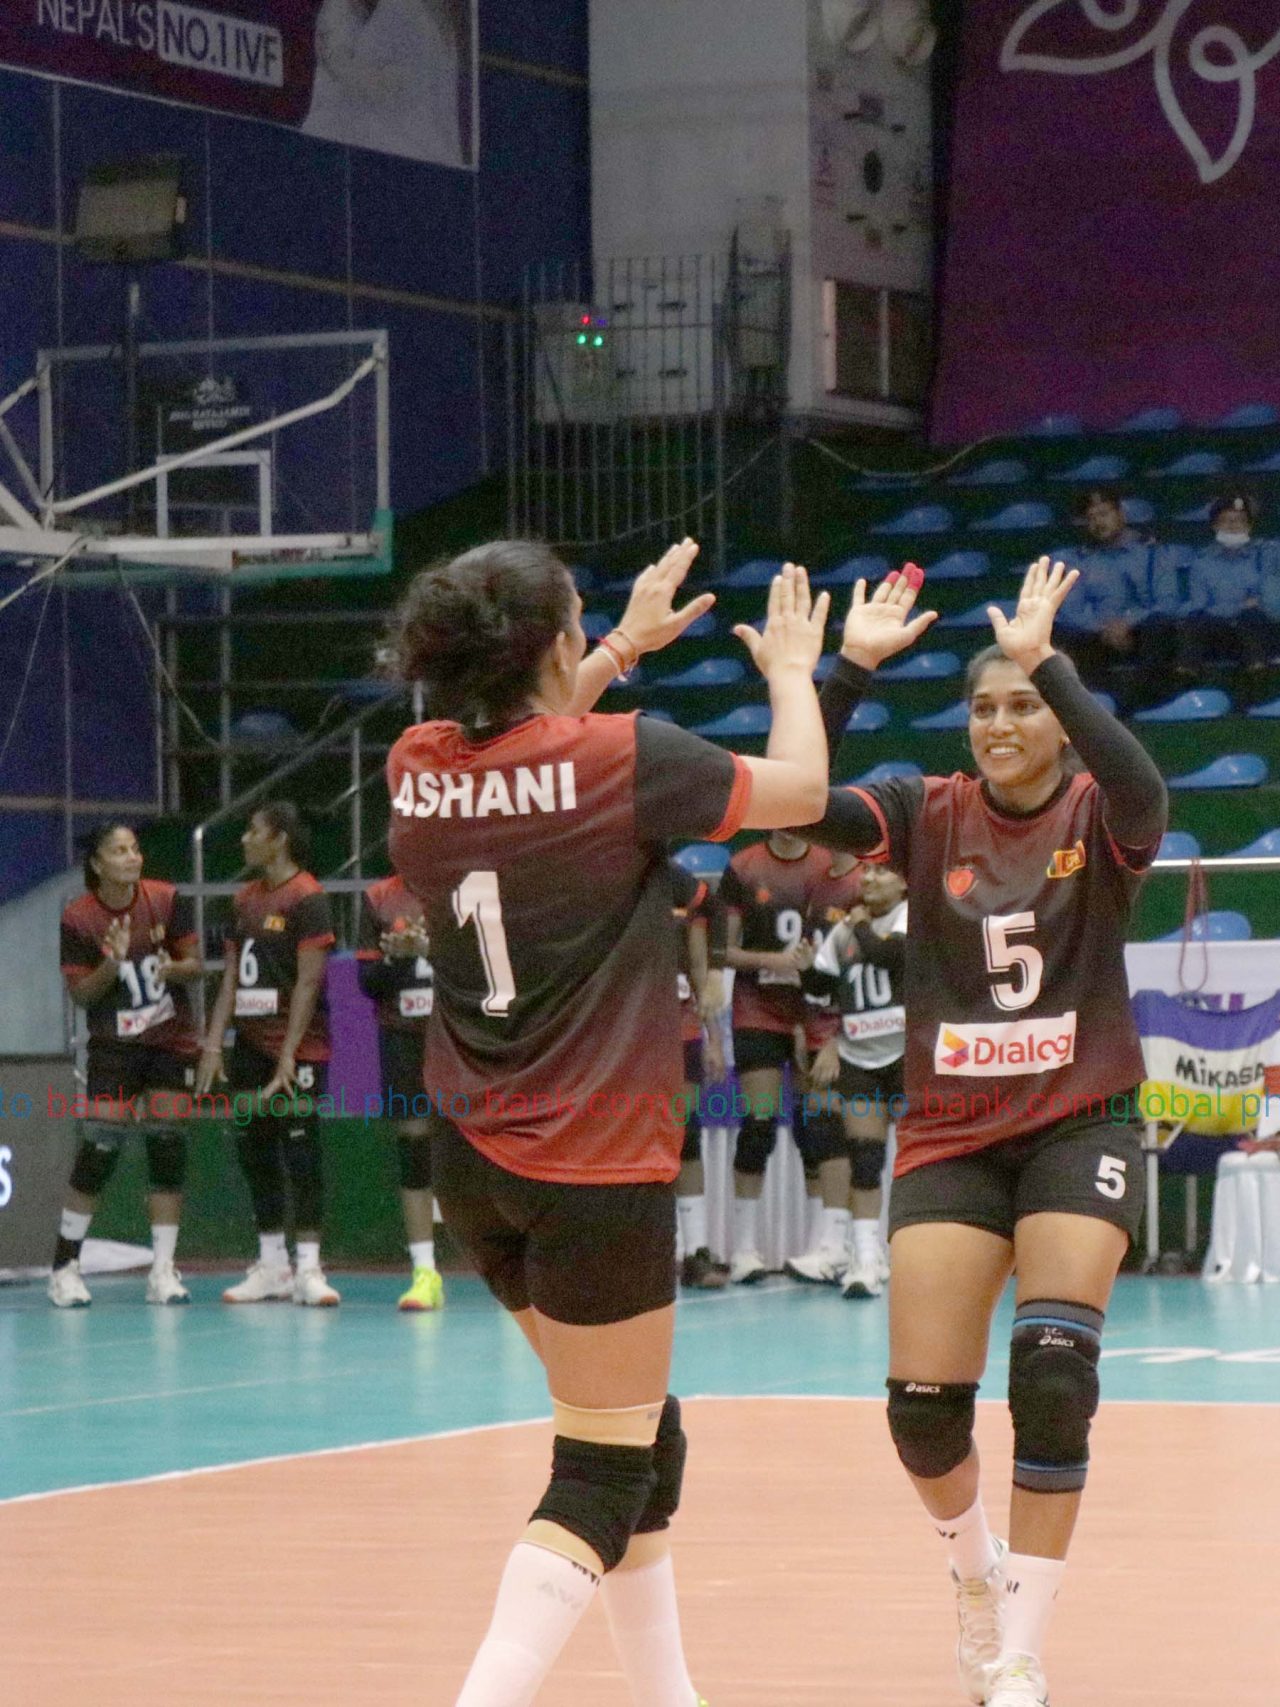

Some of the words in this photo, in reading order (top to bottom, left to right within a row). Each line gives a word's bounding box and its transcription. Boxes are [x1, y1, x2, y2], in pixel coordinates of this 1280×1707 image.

[37, 0, 155, 50] NEPAL'S
[161, 10, 228, 67] NO.1
[235, 28, 279, 77] IVF
[392, 761, 577, 818] ASHANI
[452, 871, 517, 1018] 1
[776, 909, 803, 952] 9
[240, 938, 259, 986] 6
[982, 911, 1044, 1011] 5
[847, 963, 892, 1010] 10
[973, 1033, 1073, 1065] Dialog
[1094, 1154, 1127, 1200] 5
[914, 1384, 941, 1394] asics
